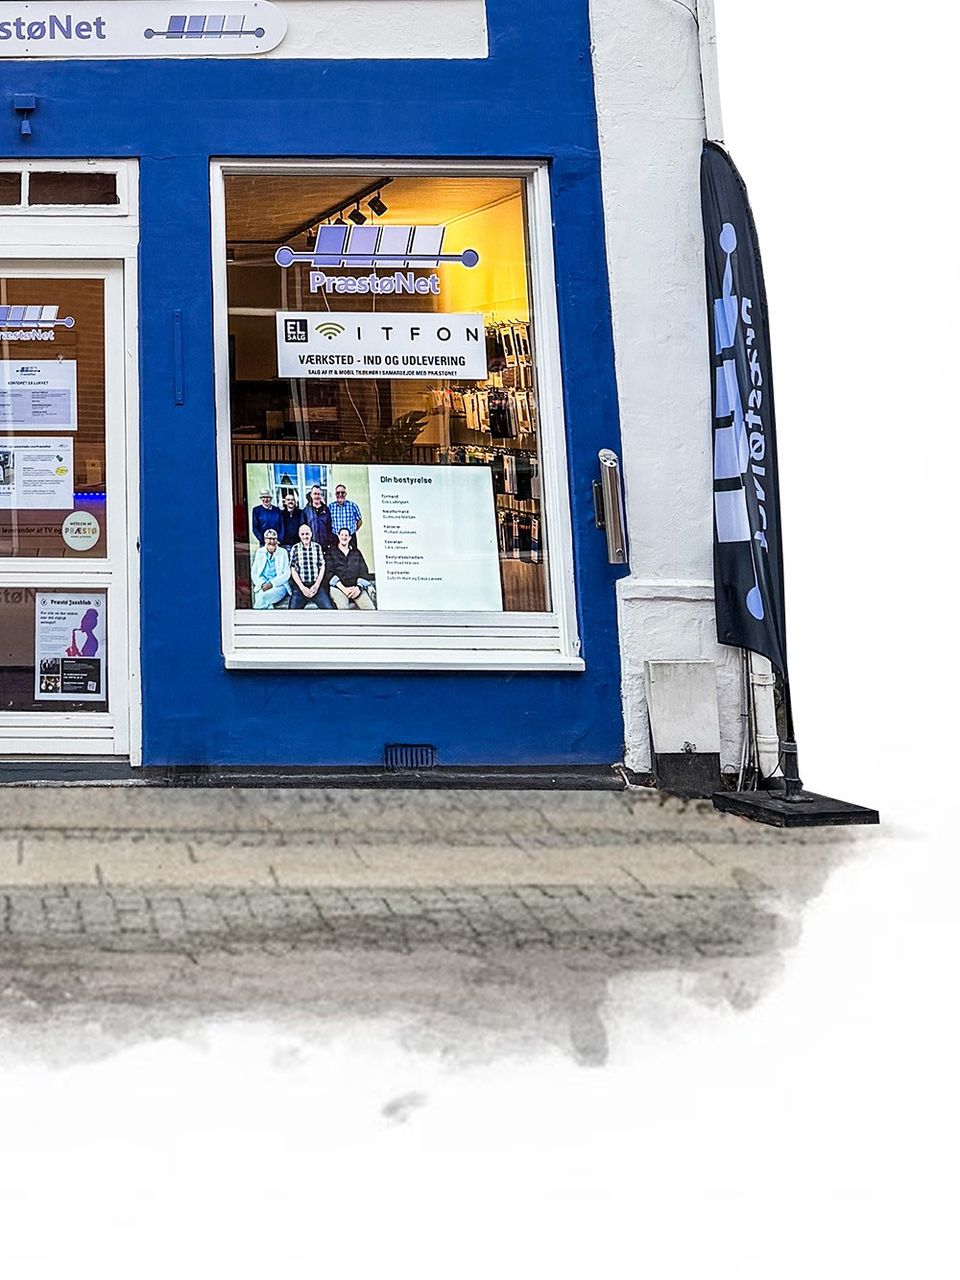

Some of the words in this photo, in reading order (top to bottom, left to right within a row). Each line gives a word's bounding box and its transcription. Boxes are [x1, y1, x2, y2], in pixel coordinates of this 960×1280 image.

[310, 271, 441, 295] PræstøNet
[287, 321, 305, 334] EL
[298, 355, 354, 365] VÆRKSTED
[363, 355, 382, 365] IND
[385, 355, 399, 365] OG
[402, 355, 466, 366] UDLEVERING
[393, 476, 433, 485] bestyrelse
